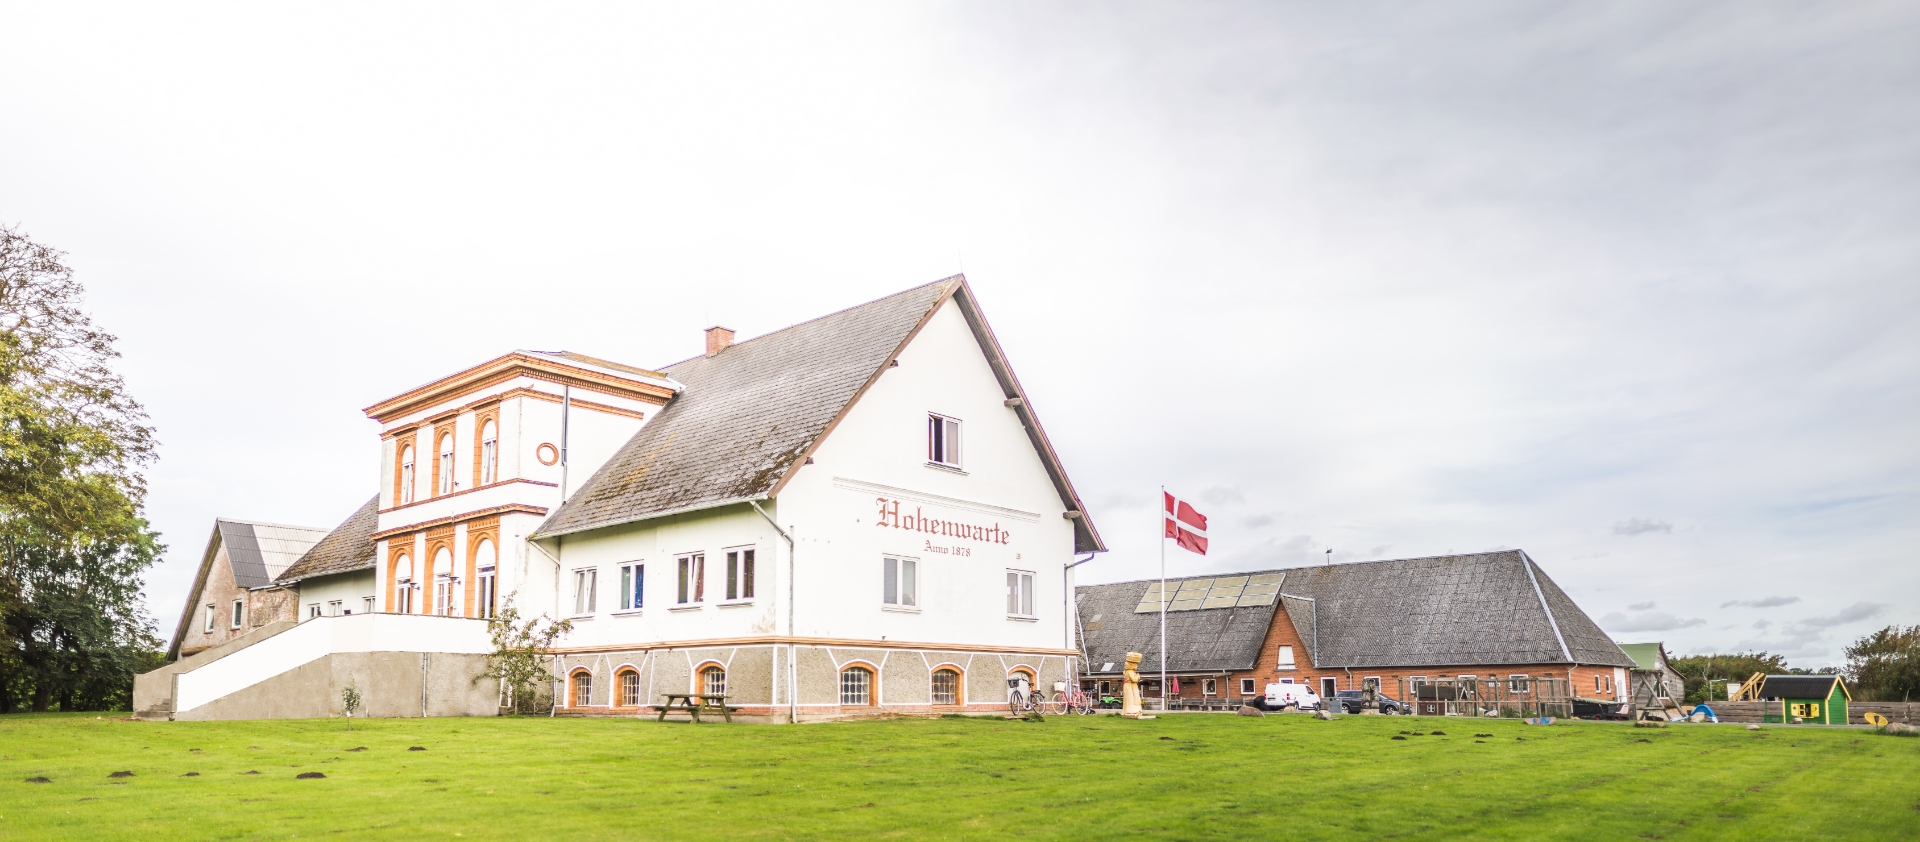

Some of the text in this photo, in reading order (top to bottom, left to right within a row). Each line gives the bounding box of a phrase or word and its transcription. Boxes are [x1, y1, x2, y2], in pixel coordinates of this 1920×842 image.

[876, 497, 1010, 545] Hohenwarte
[923, 539, 971, 557] Anno 1878
